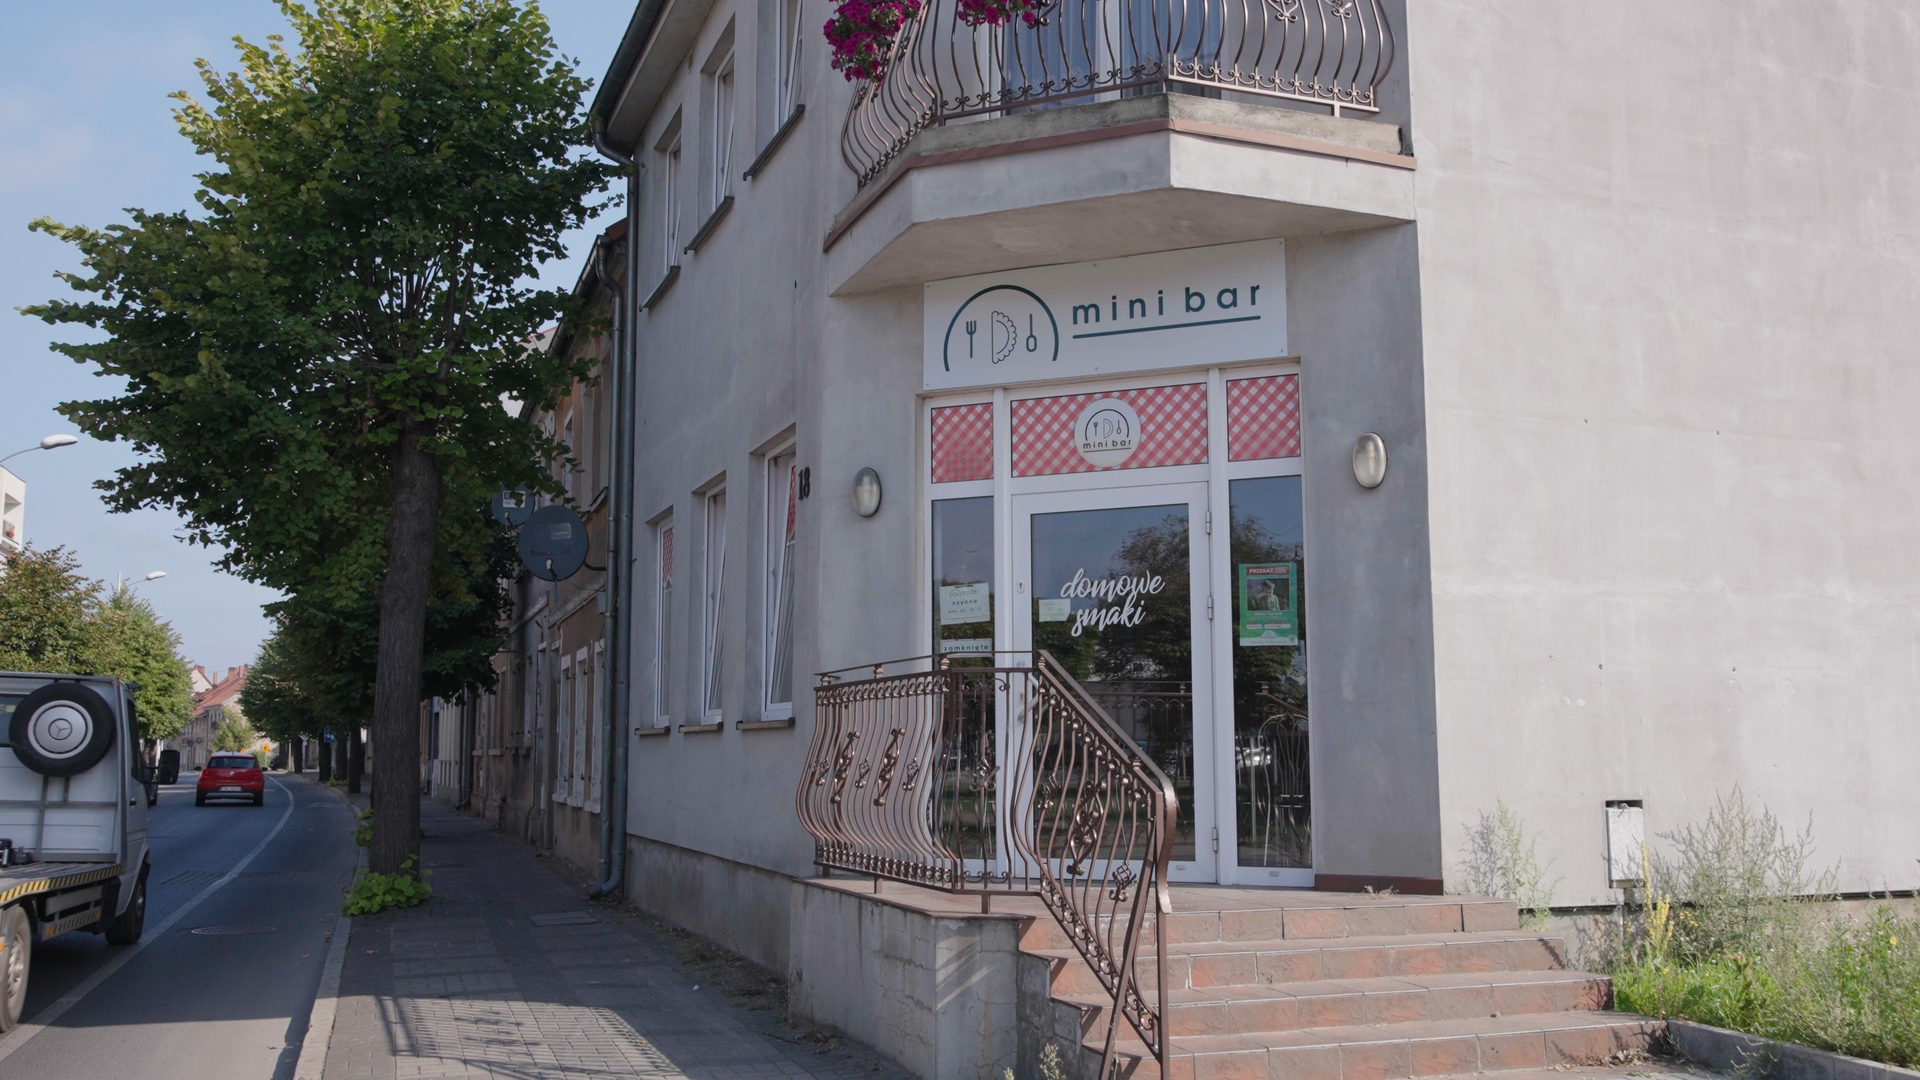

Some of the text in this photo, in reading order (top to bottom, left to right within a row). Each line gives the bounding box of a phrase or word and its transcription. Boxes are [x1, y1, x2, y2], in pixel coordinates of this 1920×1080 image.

[1072, 284, 1260, 325] mini bar
[1083, 439, 1131, 449] mini bar
[798, 466, 810, 501] 18
[1060, 568, 1165, 602] domowe
[1071, 594, 1146, 637] smaki
